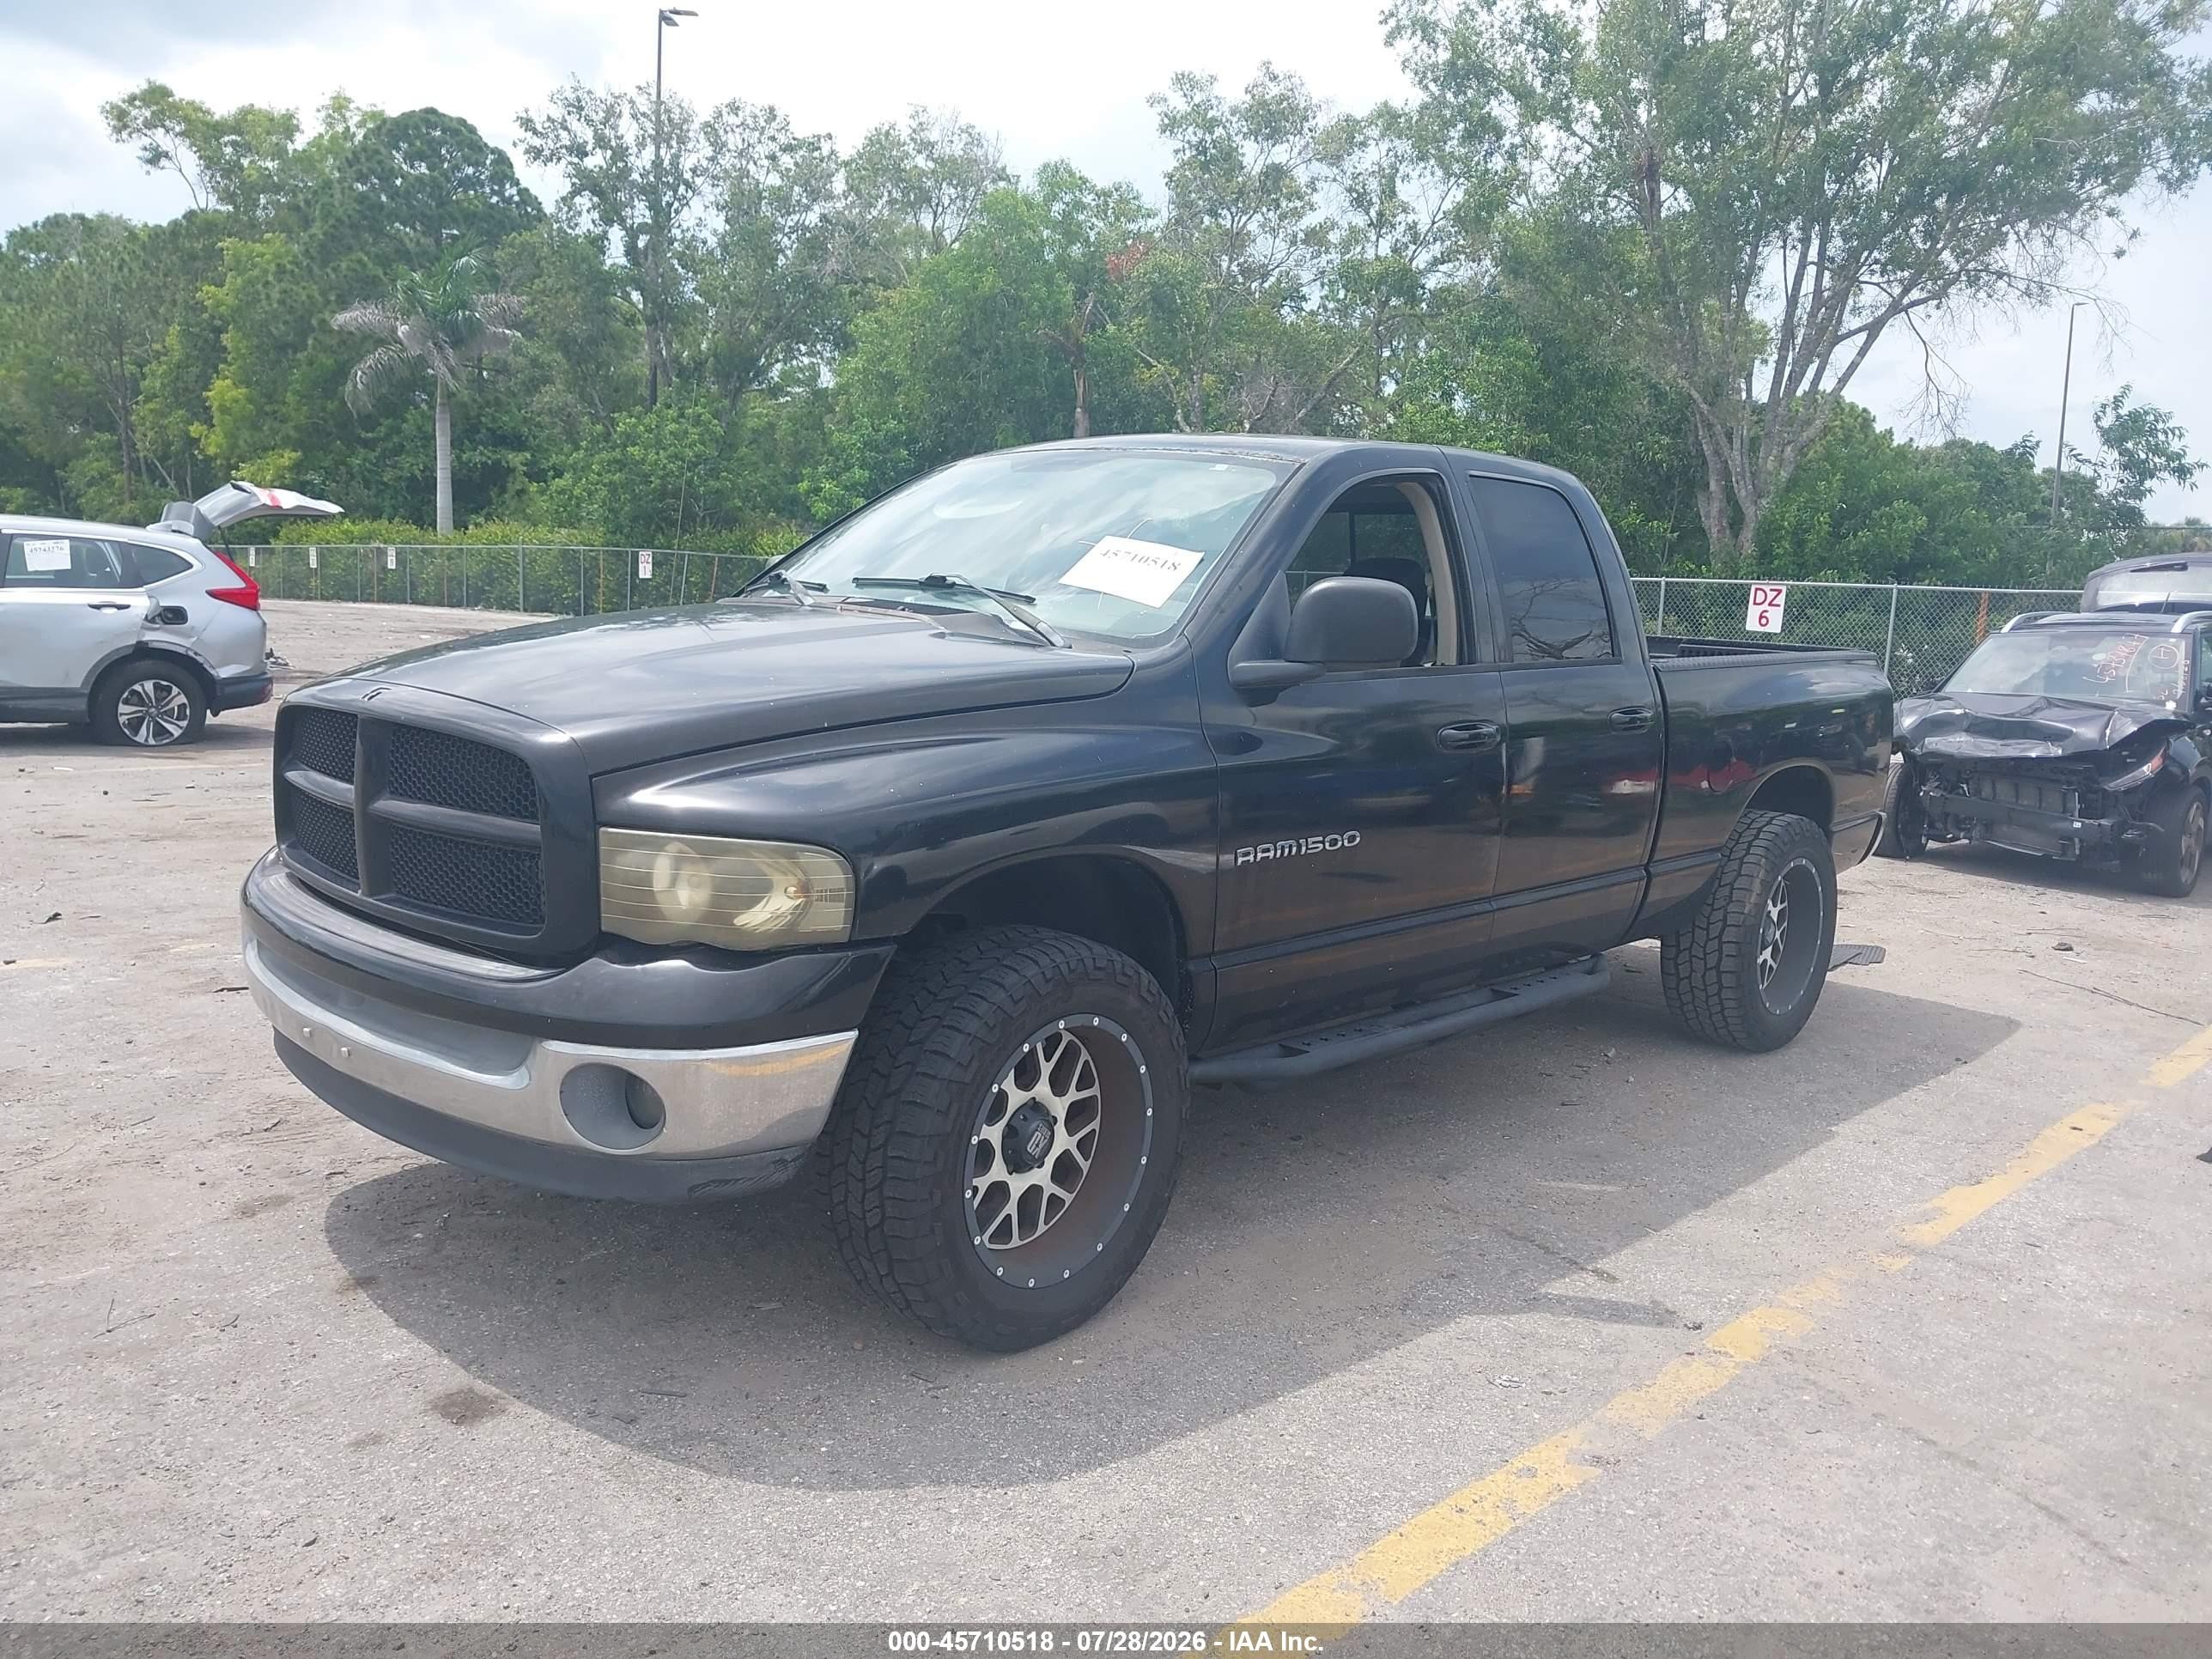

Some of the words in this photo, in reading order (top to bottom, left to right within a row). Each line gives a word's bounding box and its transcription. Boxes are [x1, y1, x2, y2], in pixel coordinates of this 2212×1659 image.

[640, 553, 651, 564] DZ
[1100, 549, 1182, 571] 45710518
[1753, 587, 1783, 607] DZ
[1758, 609, 1770, 628] 6
